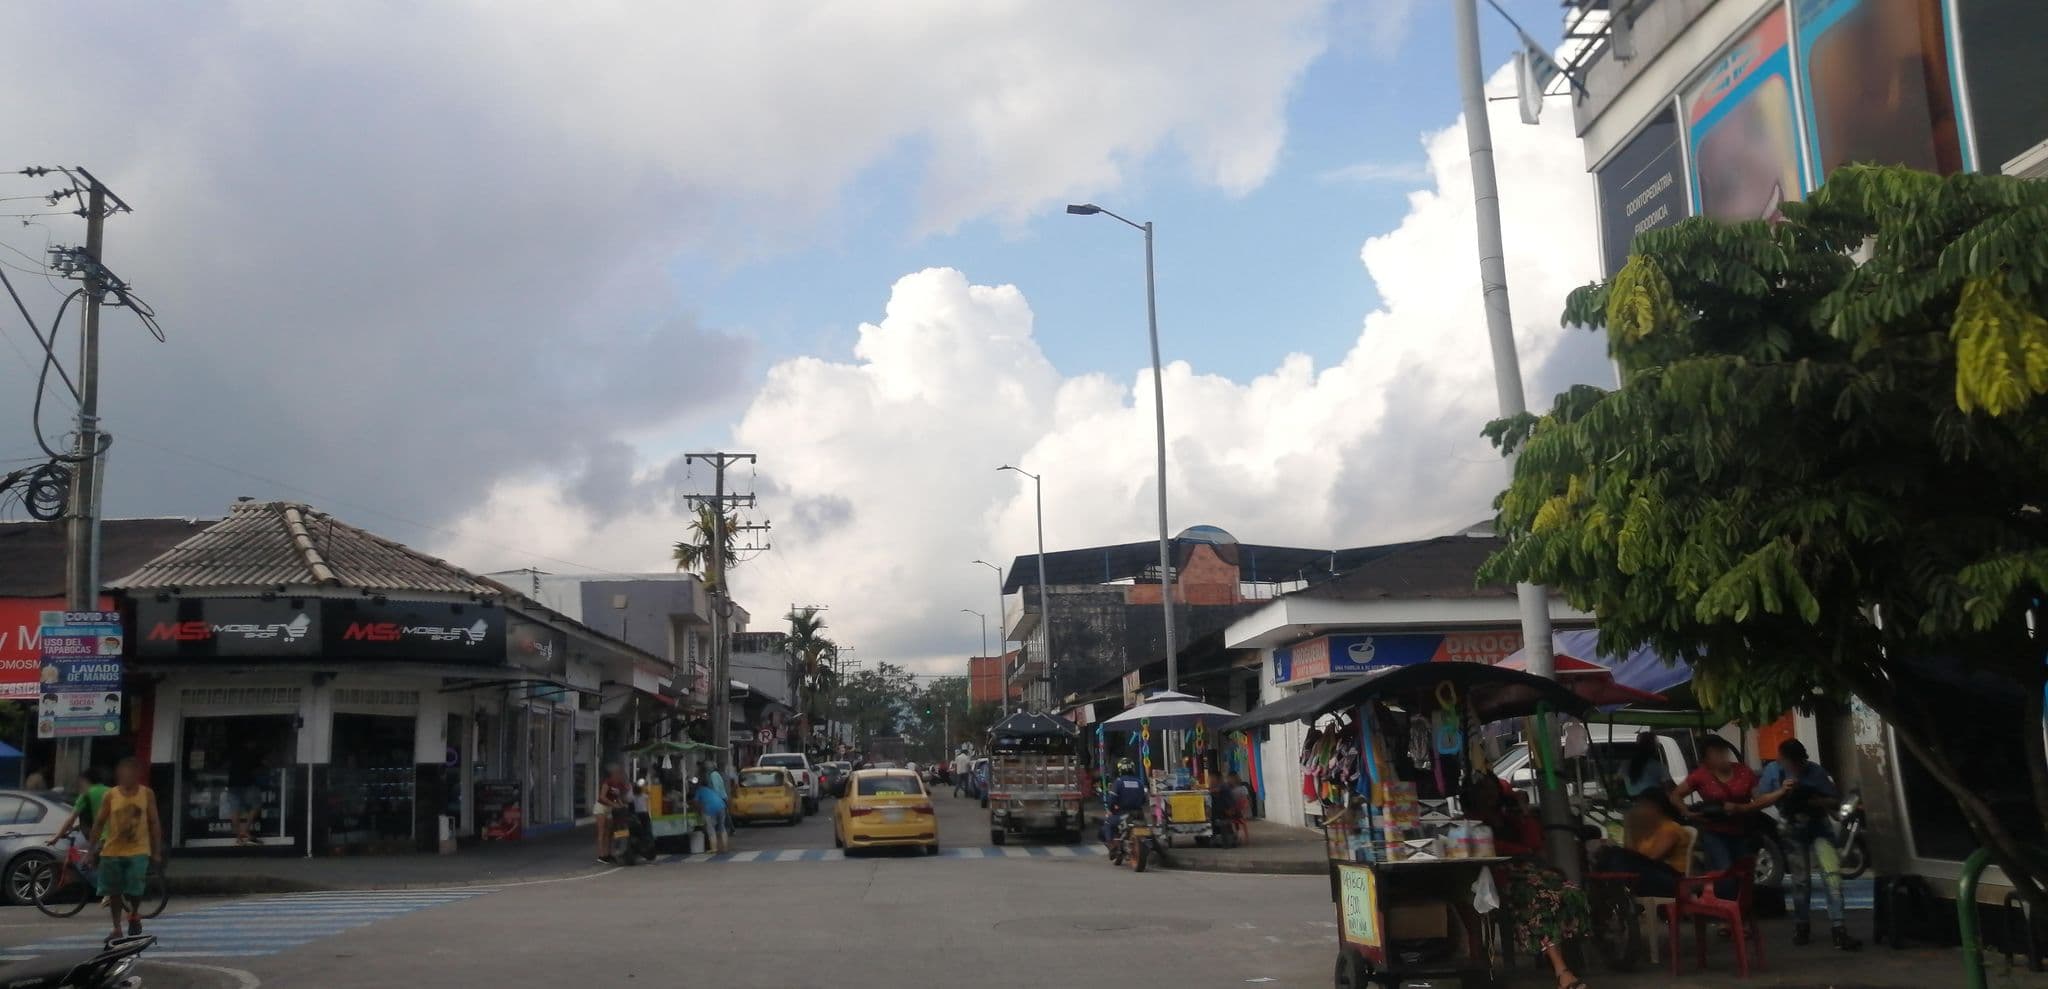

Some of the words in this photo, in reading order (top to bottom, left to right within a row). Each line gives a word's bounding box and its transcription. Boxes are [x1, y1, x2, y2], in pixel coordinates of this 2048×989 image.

[1626, 171, 1673, 217] ODONTOPEDIATRIA
[64, 611, 103, 622] COVID
[105, 611, 121, 622] 19
[212, 623, 282, 633] MOBILE
[401, 625, 465, 636] MOBILE
[43, 638, 64, 647] USO
[65, 638, 83, 647] DEL
[44, 646, 92, 655] TAPABOCAS
[1451, 655, 1509, 666] SANT
[71, 663, 120, 673] LAVADO
[67, 673, 82, 682] DE
[83, 673, 120, 682] MANOS
